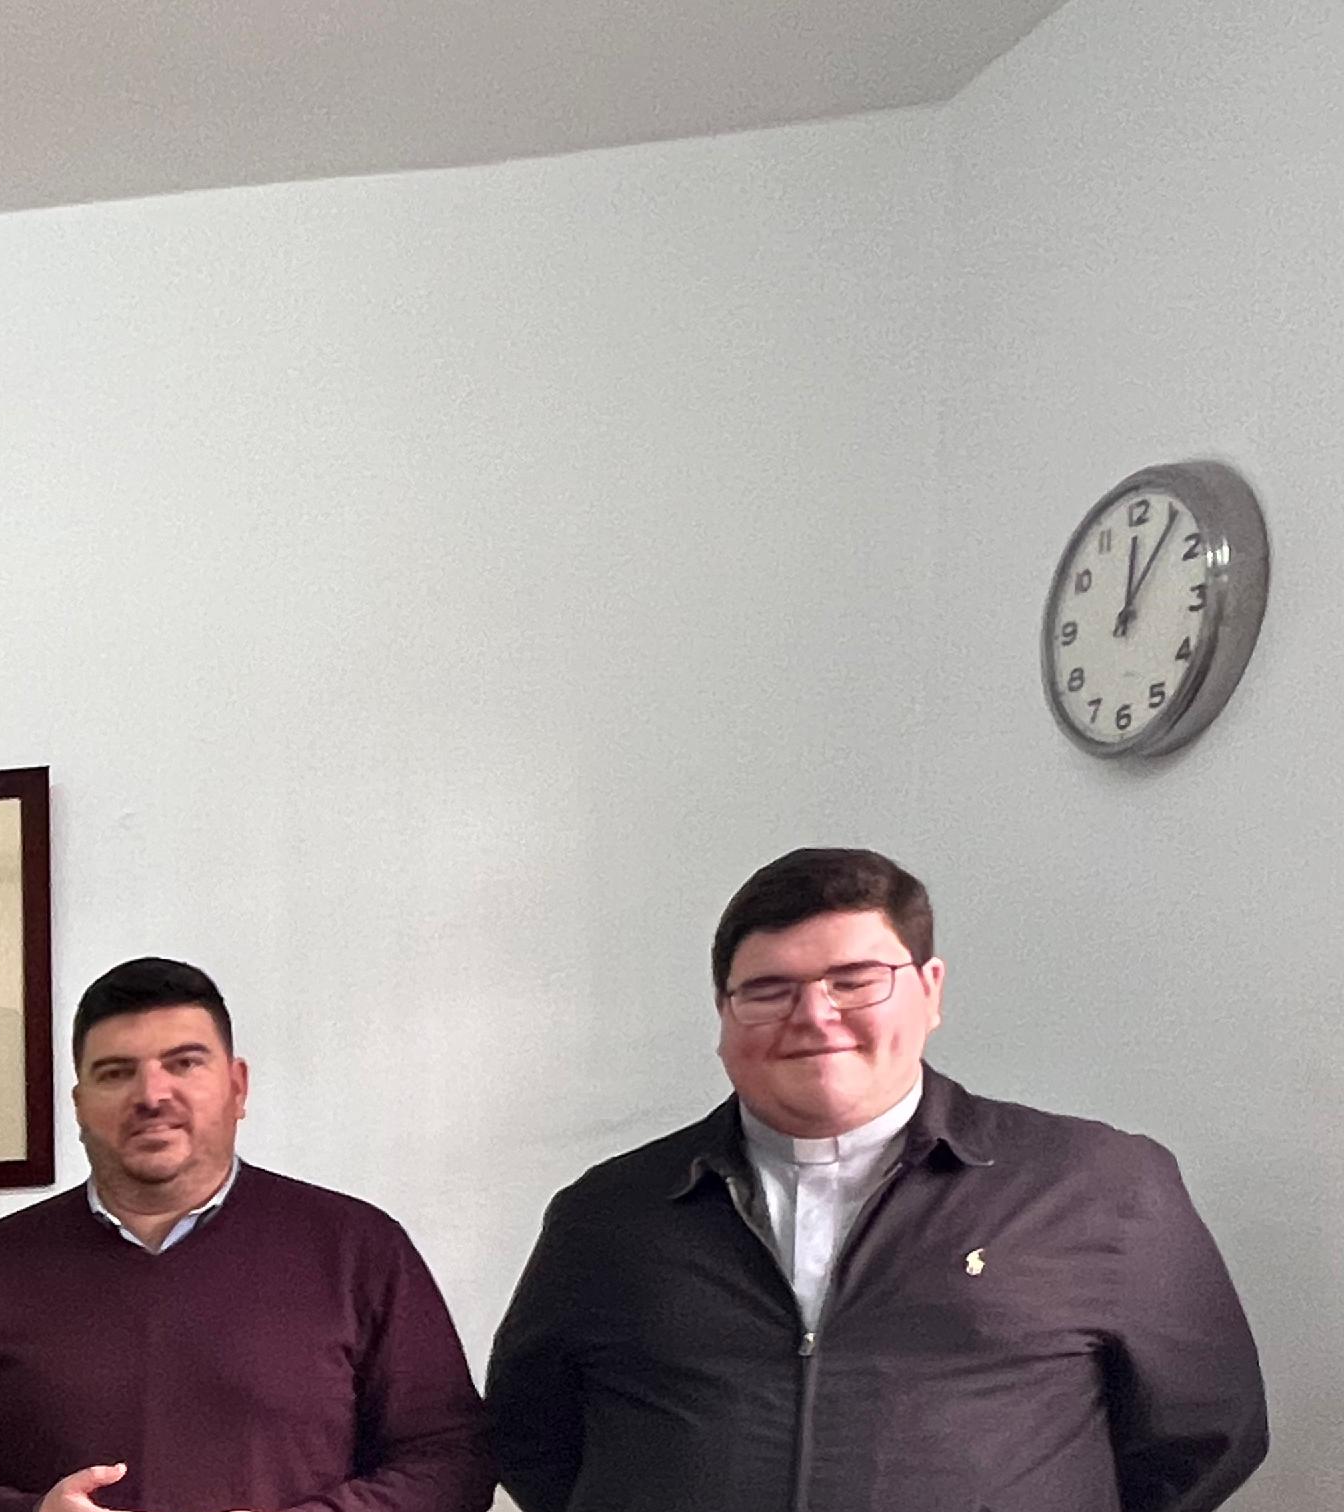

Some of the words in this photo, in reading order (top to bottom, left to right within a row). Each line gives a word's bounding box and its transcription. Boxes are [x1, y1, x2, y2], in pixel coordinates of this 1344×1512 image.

[1128, 499, 1151, 528] 12
[1098, 527, 1112, 554] 11
[1182, 533, 1201, 561] 2
[1074, 568, 1092, 595] 10
[1188, 583, 1206, 612] 3
[1061, 620, 1078, 646] 9
[1174, 636, 1192, 662] 4
[1067, 666, 1085, 692] 8
[1148, 682, 1166, 709] 5
[1087, 697, 1103, 723] 7
[1115, 703, 1132, 730] 6
